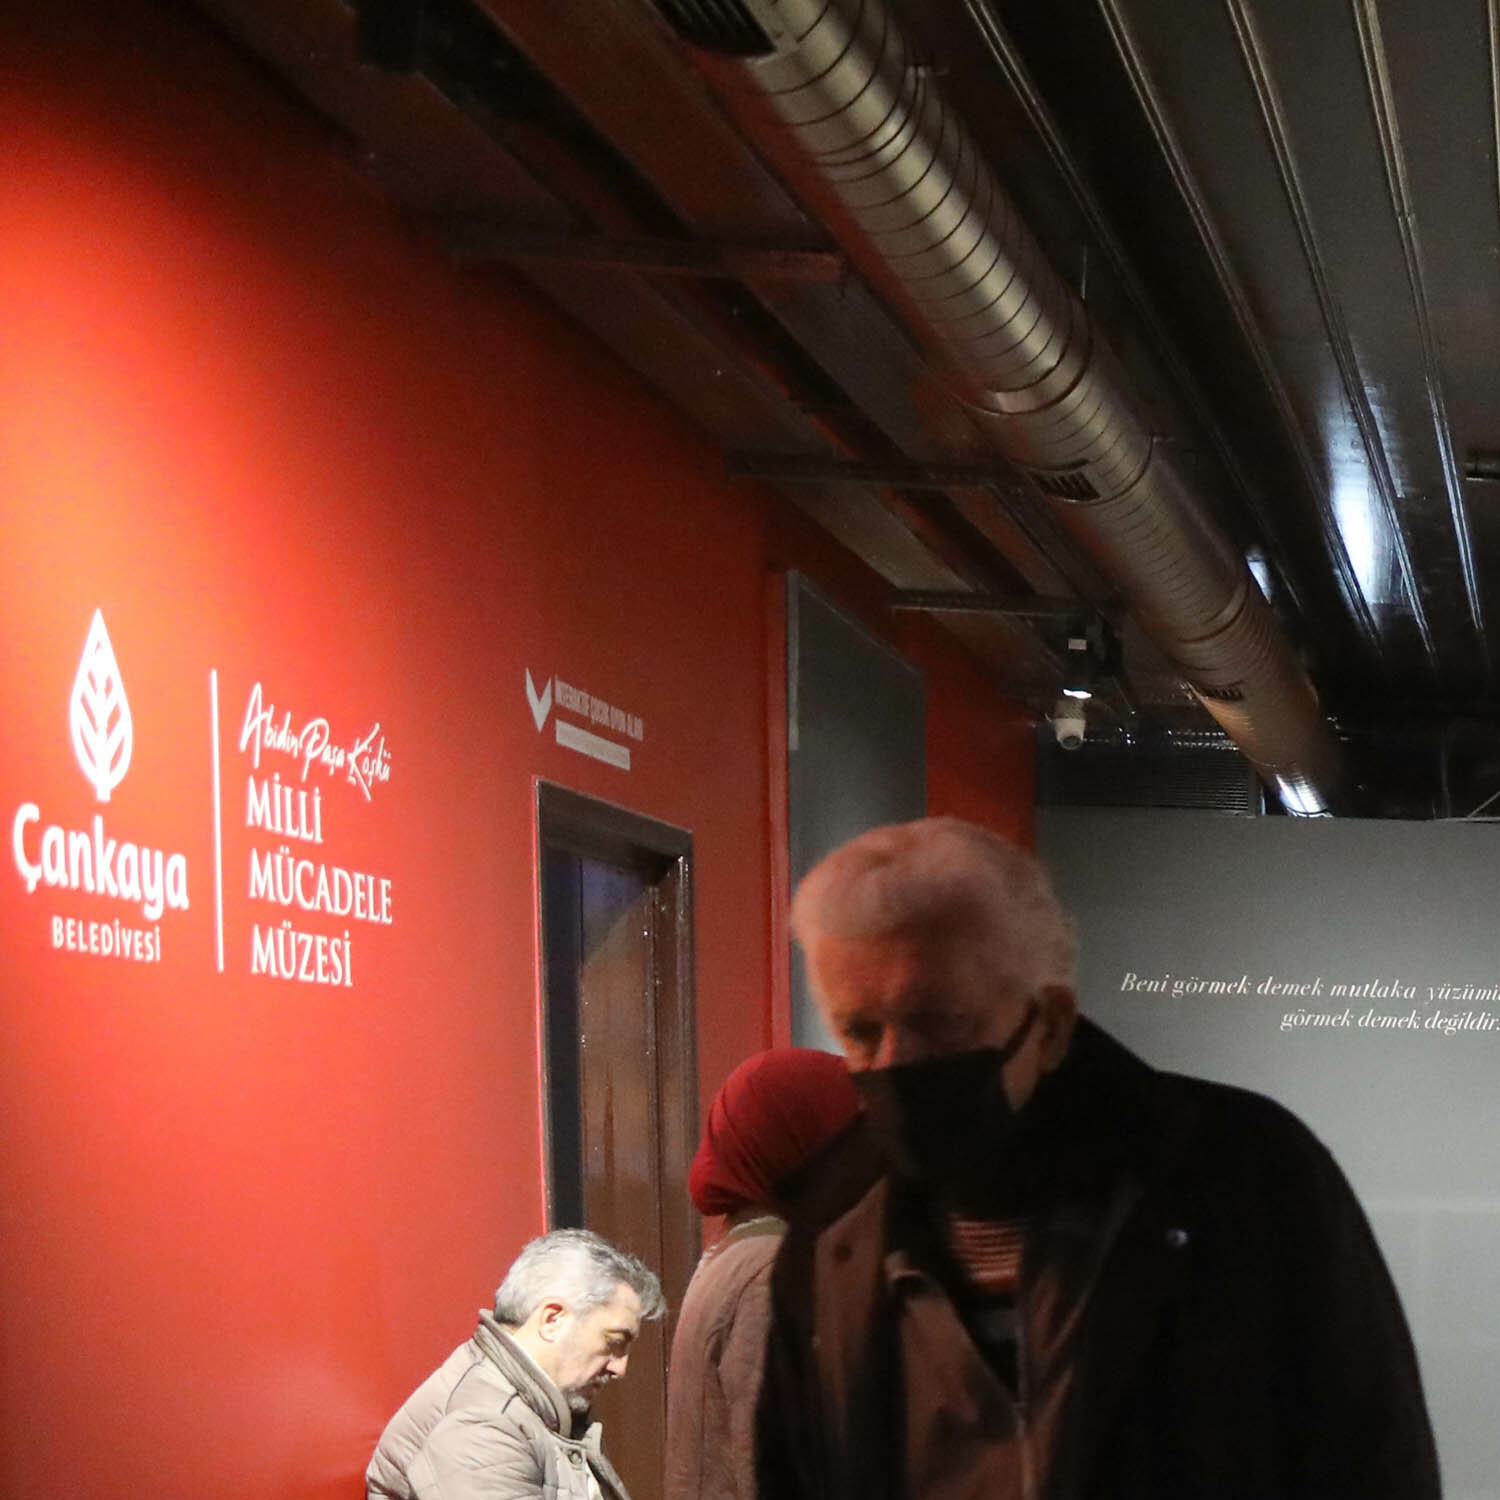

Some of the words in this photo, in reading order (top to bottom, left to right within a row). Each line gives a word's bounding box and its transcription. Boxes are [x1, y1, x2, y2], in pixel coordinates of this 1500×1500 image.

[240, 681, 299, 769] Abidin
[299, 717, 344, 782] Paşa
[347, 722, 392, 802] Köşkü
[246, 772, 323, 843] MİLLİ
[13, 802, 190, 921] Çankaya
[249, 846, 393, 924] MÜCADELE
[52, 915, 161, 962] BELEDİYESİ
[251, 920, 353, 987] MÜZESİ
[1120, 972, 1170, 993] Beni
[1171, 976, 1252, 999] görmek
[1256, 976, 1325, 997] demek
[1329, 978, 1417, 999] mutlaka
[1279, 1008, 1354, 1032] görmek
[1357, 1008, 1421, 1030] demek
[1424, 1010, 1500, 1036] değildir.
